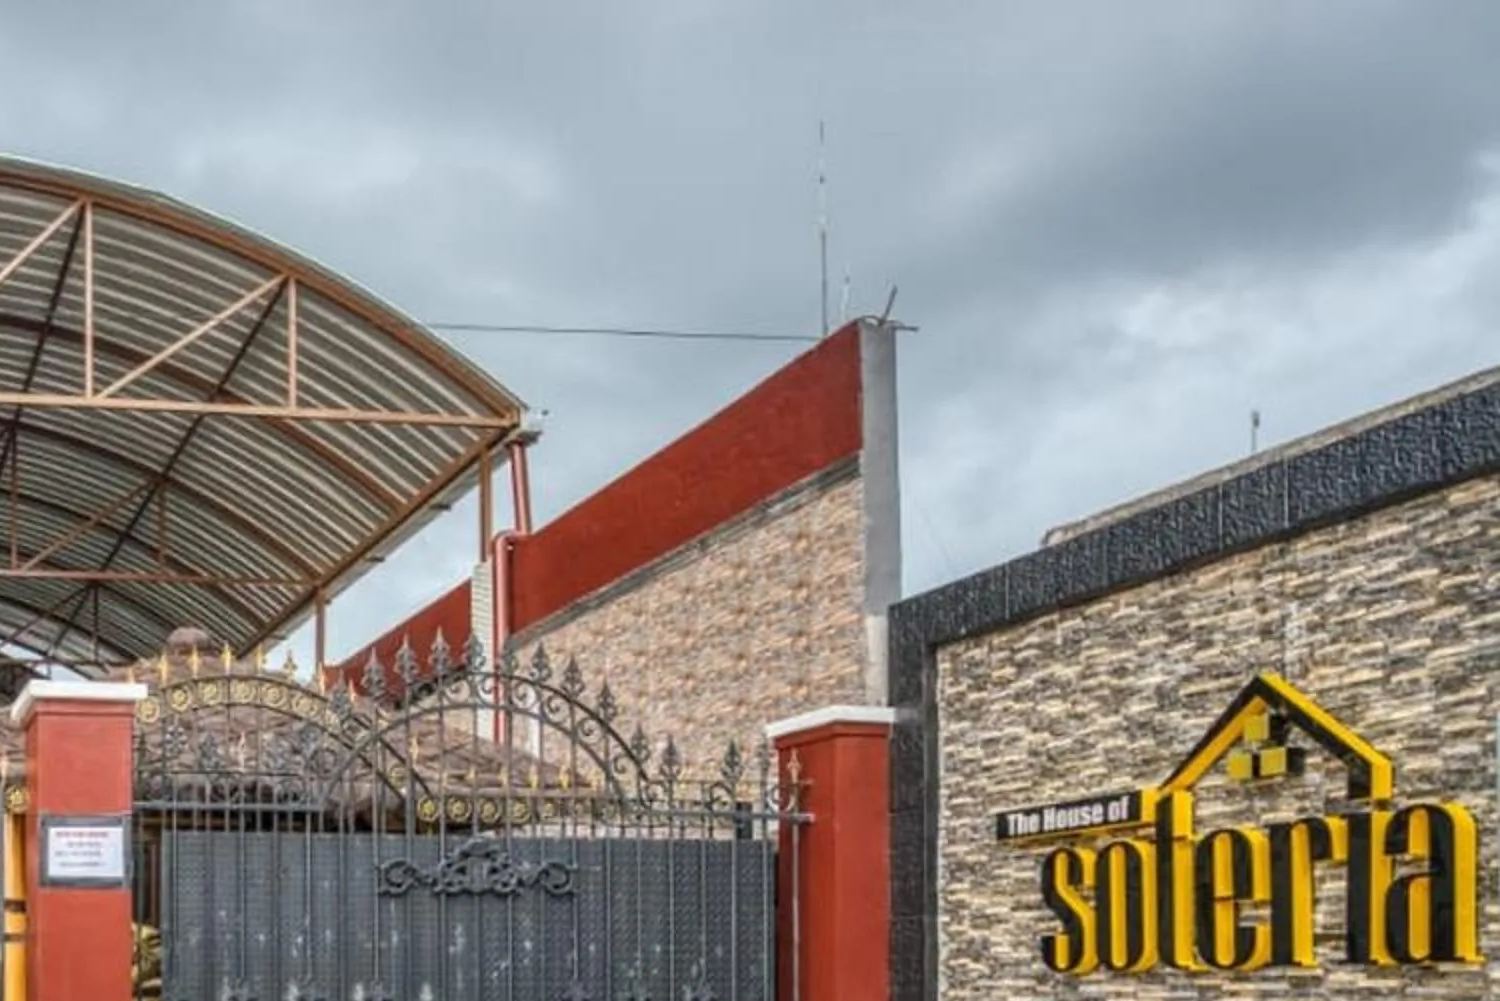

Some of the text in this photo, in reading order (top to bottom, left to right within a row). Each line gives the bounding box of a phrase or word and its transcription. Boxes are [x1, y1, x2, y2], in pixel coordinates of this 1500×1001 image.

[1007, 795, 1130, 836] The House of
[1040, 788, 1484, 975] soteria
